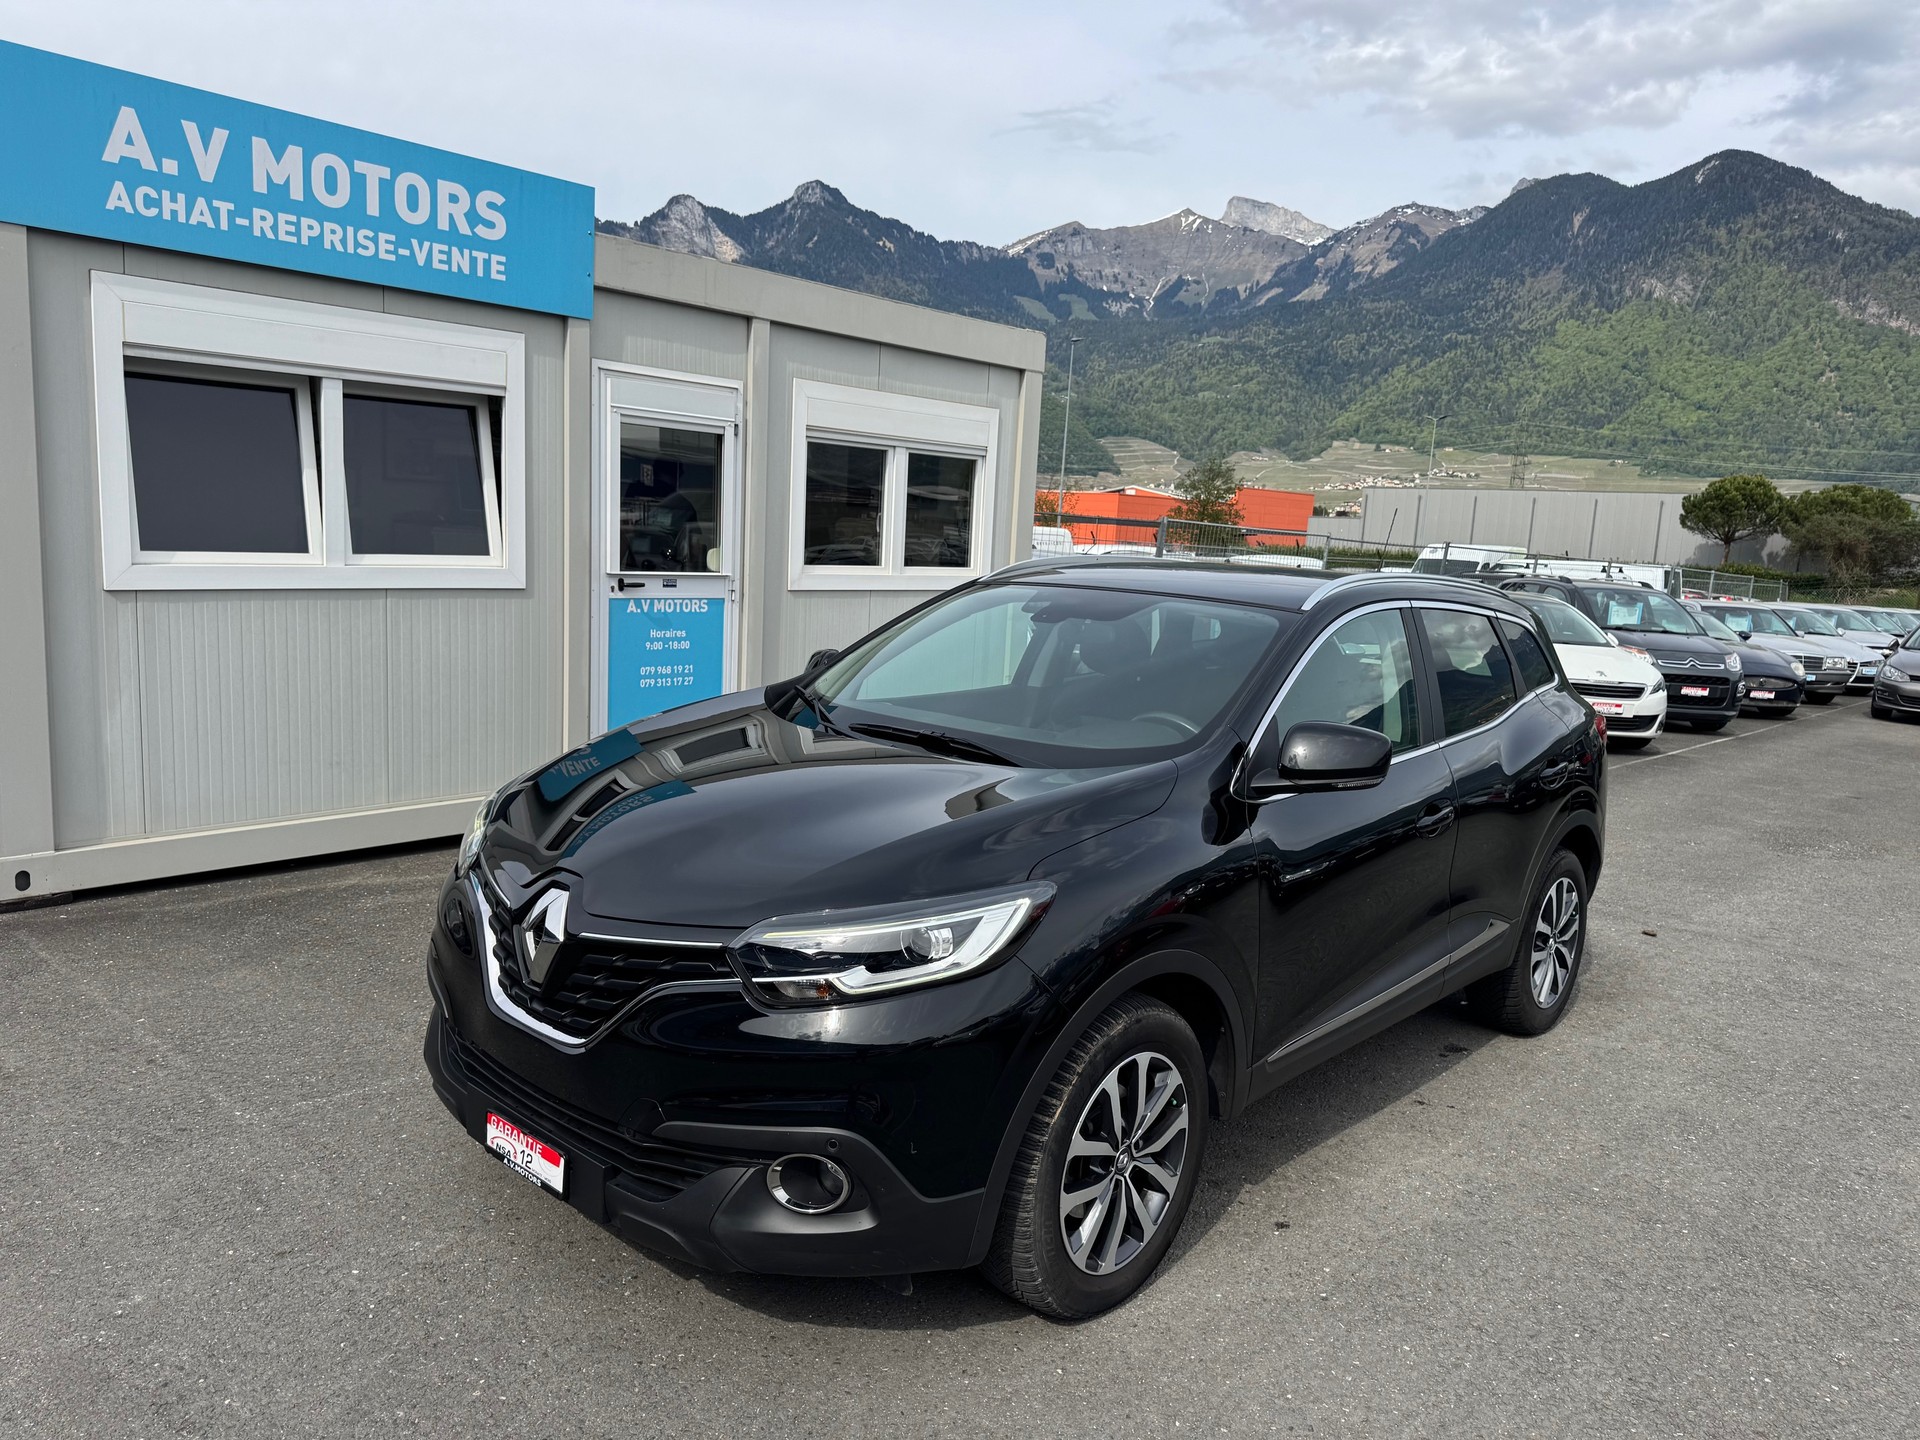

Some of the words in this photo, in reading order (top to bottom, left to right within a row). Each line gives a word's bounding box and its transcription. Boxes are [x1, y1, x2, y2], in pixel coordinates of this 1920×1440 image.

[101, 105, 230, 183] A.V
[251, 136, 507, 241] MOTORS
[105, 180, 507, 281] ACHAT-REPRISE-VENTE
[627, 599, 650, 613] A.V
[654, 599, 708, 613] MOTORS
[650, 629, 686, 638] Horaires
[645, 641, 663, 650] 9:00
[640, 666, 655, 675] 079
[657, 665, 672, 675] 968
[673, 665, 682, 674] 19
[684, 664, 693, 673] 21
[640, 678, 655, 688] 079
[656, 678, 672, 687] 313
[673, 677, 682, 686] 17
[684, 676, 694, 685] 27
[491, 1115, 542, 1155] GARANTIE
[495, 1142, 511, 1159] NSA
[520, 1149, 533, 1170] 12
